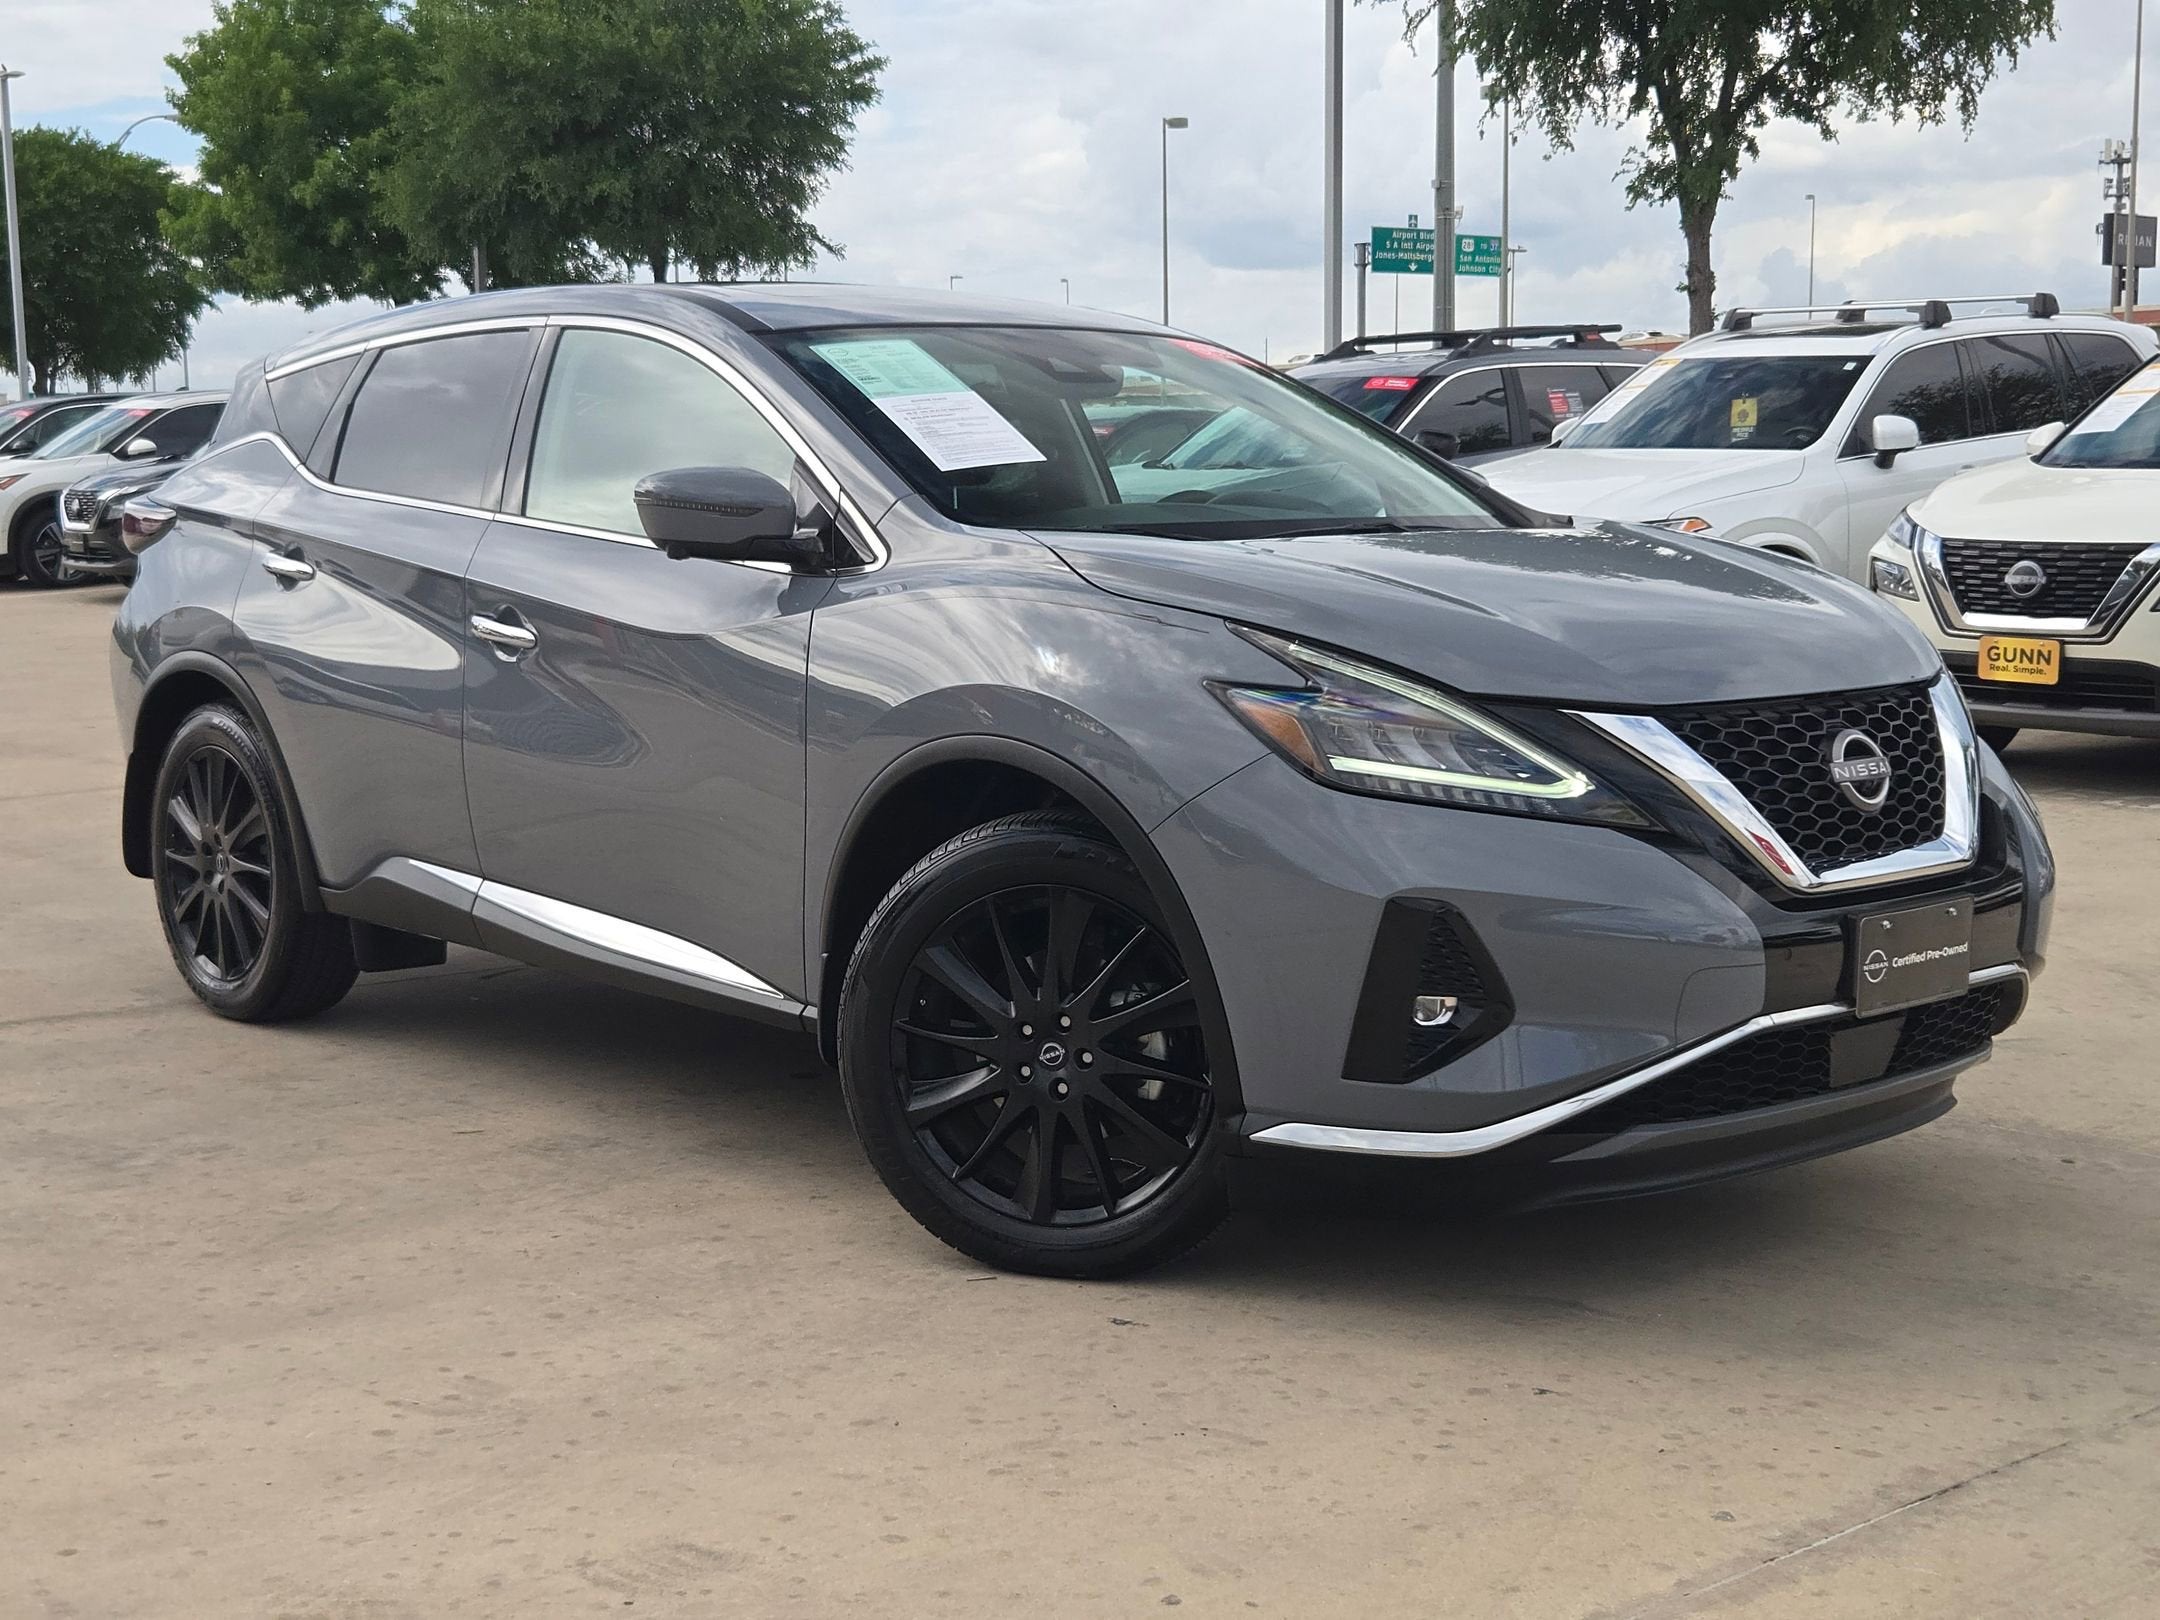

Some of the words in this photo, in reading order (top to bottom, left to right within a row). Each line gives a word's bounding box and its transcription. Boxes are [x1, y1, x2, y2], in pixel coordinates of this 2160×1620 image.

[1392, 230, 1417, 240] Airport
[1385, 240, 1391, 249] S
[1393, 240, 1398, 249] A
[1416, 241, 1434, 252] Airpo
[1459, 254, 1472, 262] San
[1474, 255, 1501, 264] Antonio
[1458, 263, 1486, 273] Johnson
[1987, 645, 2052, 666] GUNN
[1989, 663, 2011, 672] Real.
[2013, 665, 2047, 676] Simple.
[1863, 961, 1889, 971] NISSAN
[1892, 951, 1926, 968] Certified
[1926, 942, 1968, 960] Pre-Owned
